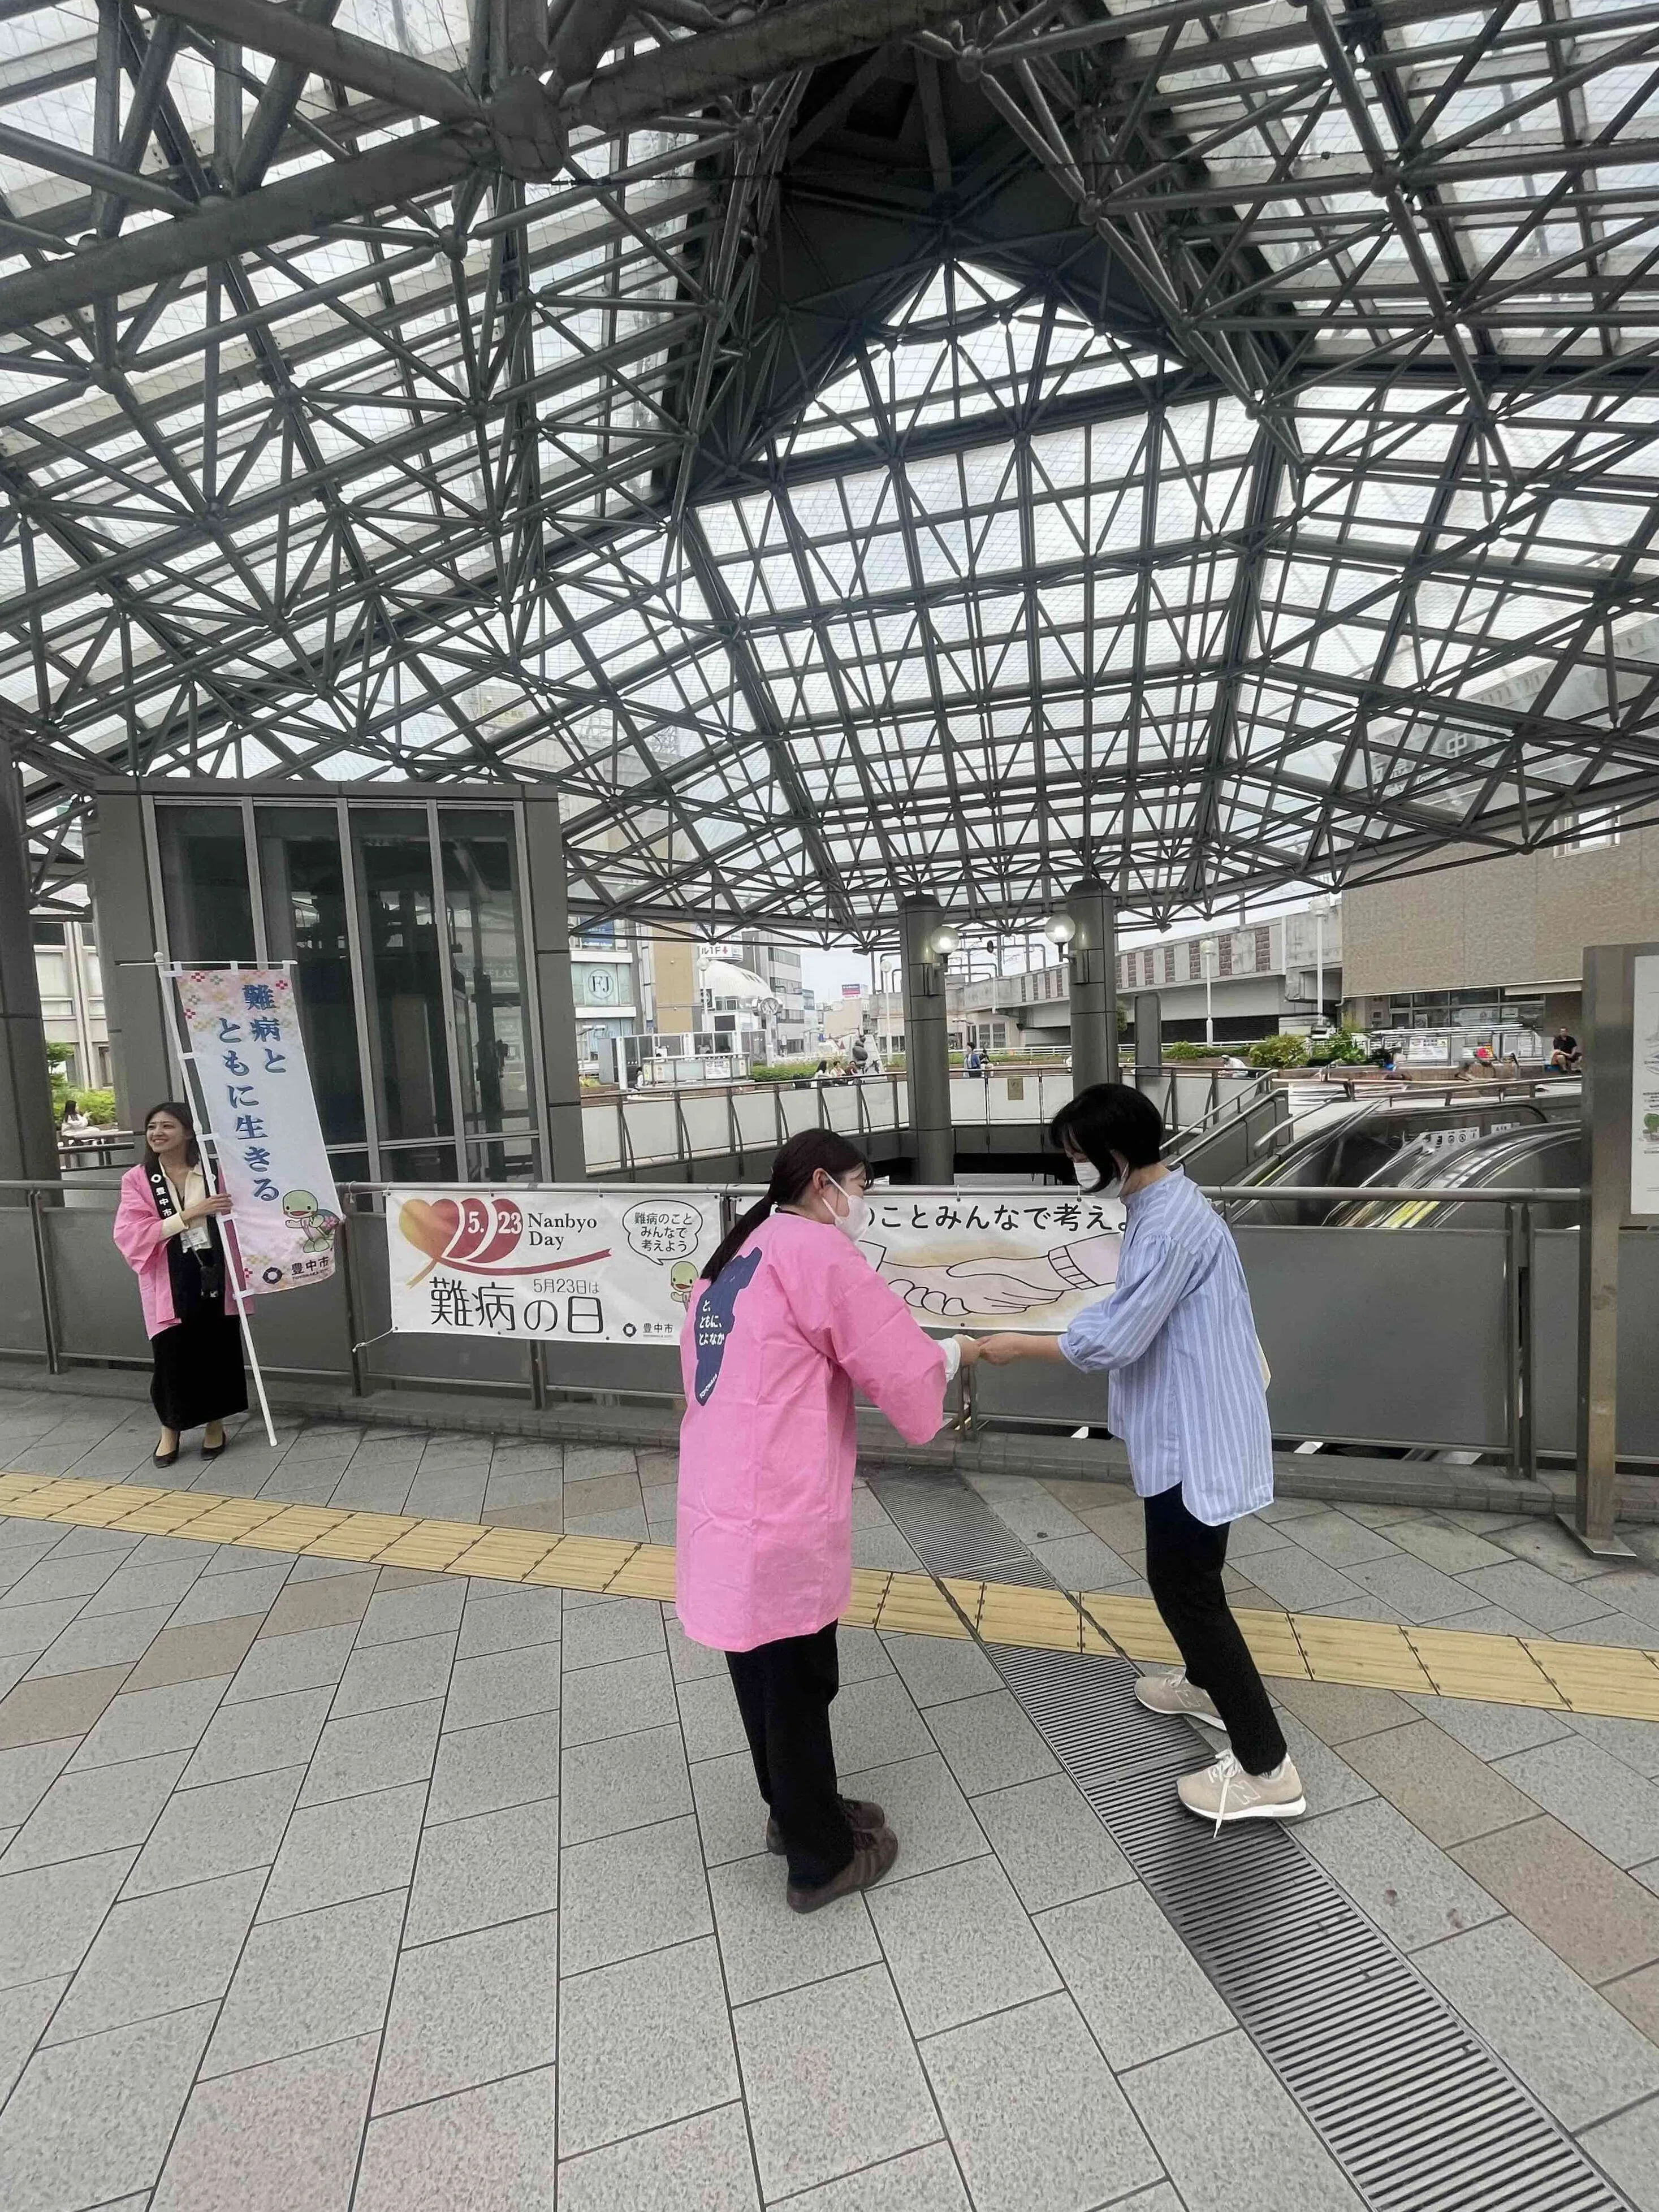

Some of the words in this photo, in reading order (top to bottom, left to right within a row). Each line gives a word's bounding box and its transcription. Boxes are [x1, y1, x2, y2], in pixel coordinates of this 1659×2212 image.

[243, 984, 287, 1073] 難病と
[218, 1018, 280, 1202] ともに生きる
[528, 1213, 597, 1233] Nanbyo
[634, 1212, 693, 1226] 難病のこと
[529, 1231, 564, 1250] Day
[641, 1227, 687, 1239] みんなで
[641, 1240, 687, 1253] 考えよう
[292, 1256, 329, 1275] 豊中市
[533, 1278, 600, 1294] 5月23日は
[429, 1276, 604, 1334] 難病の日
[643, 1322, 673, 1333] 豊中市
[699, 1332, 725, 1346] とよなか
